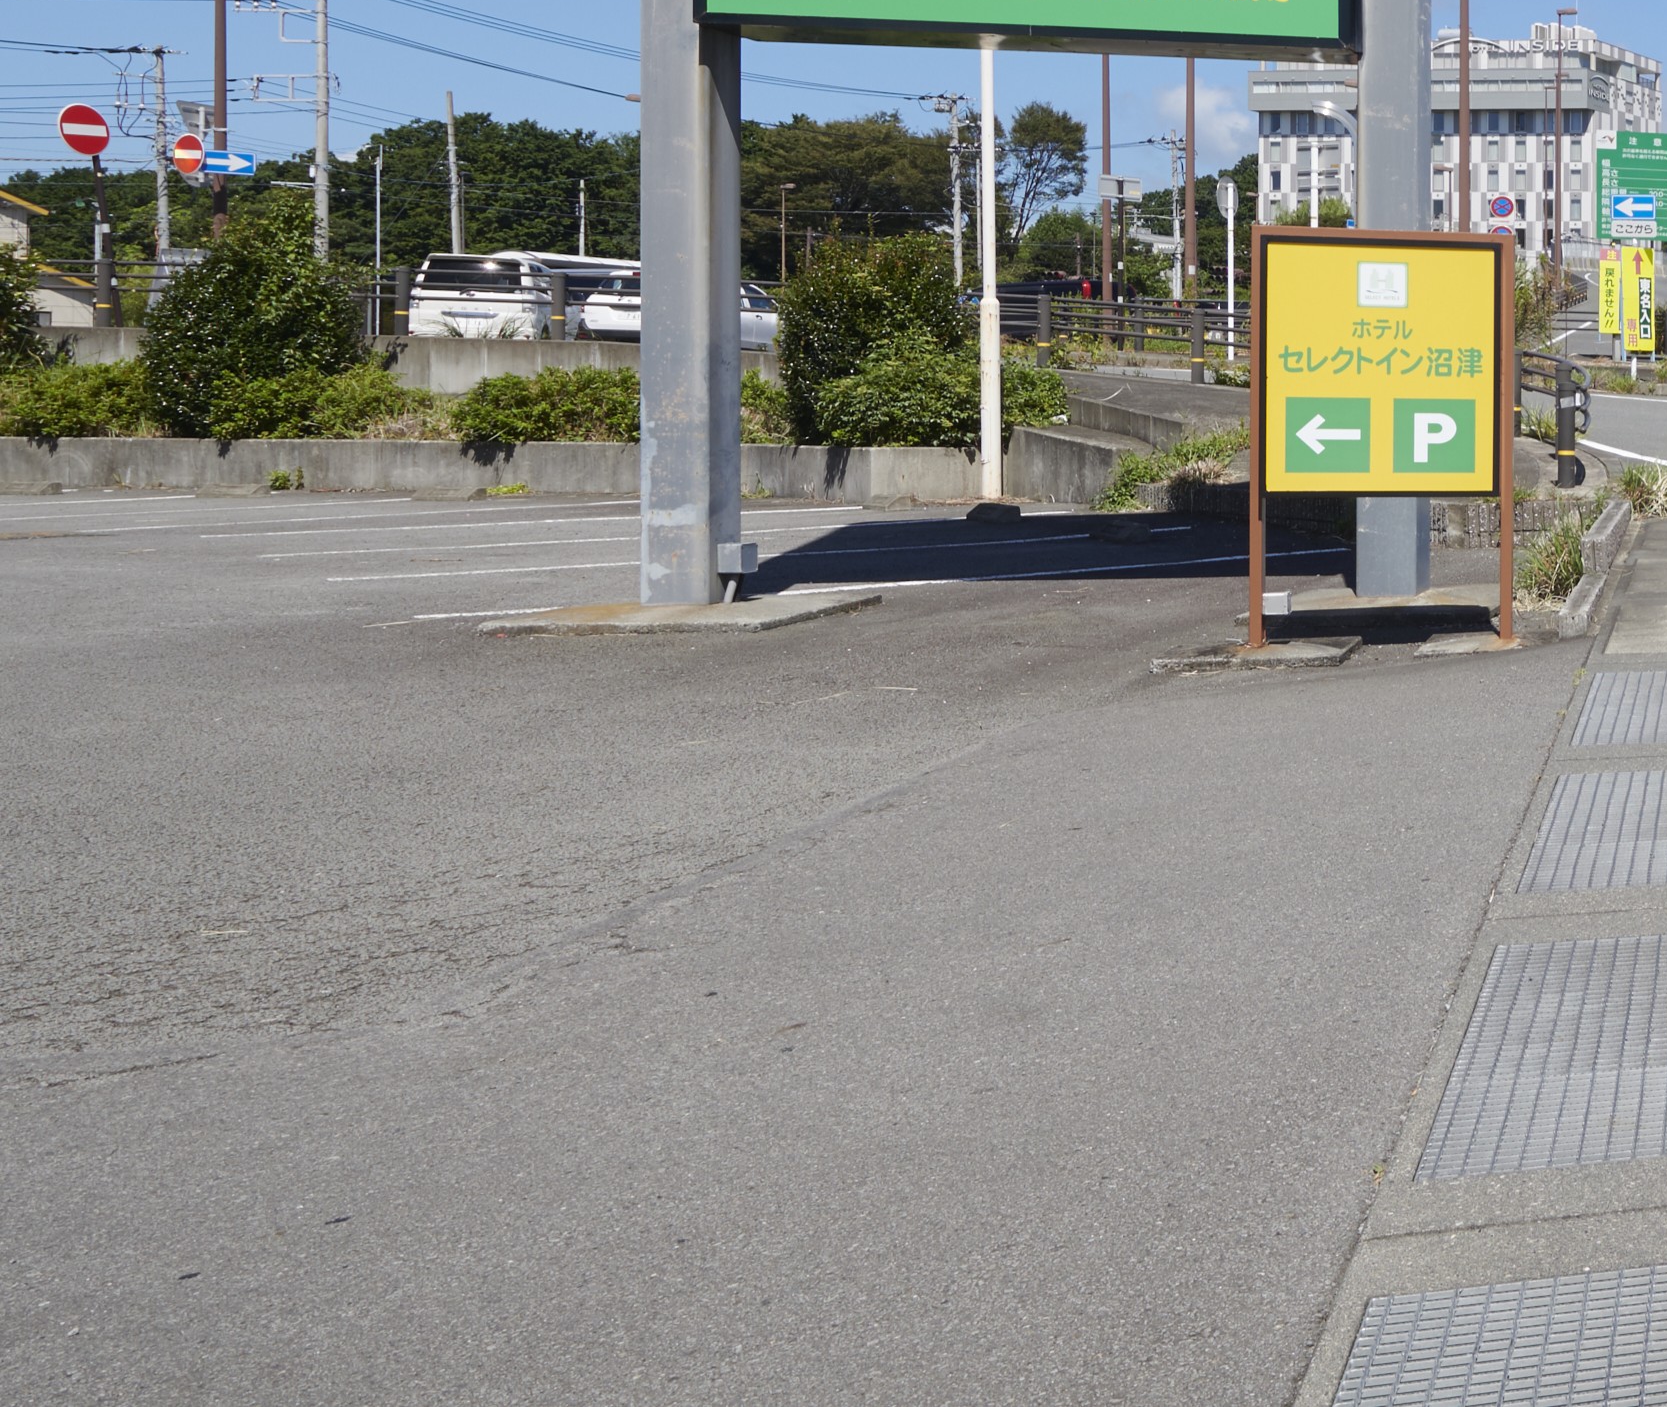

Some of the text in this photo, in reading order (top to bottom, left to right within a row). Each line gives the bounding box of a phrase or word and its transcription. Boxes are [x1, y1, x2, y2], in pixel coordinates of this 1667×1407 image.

[1510, 40, 1579, 53] INSIDE
[1615, 224, 1653, 234] ここから
[1640, 278, 1651, 339] 東名入口
[1352, 318, 1413, 340] ホテル
[1278, 345, 1483, 378] セレクトイン沼津
[1413, 413, 1457, 463] P
